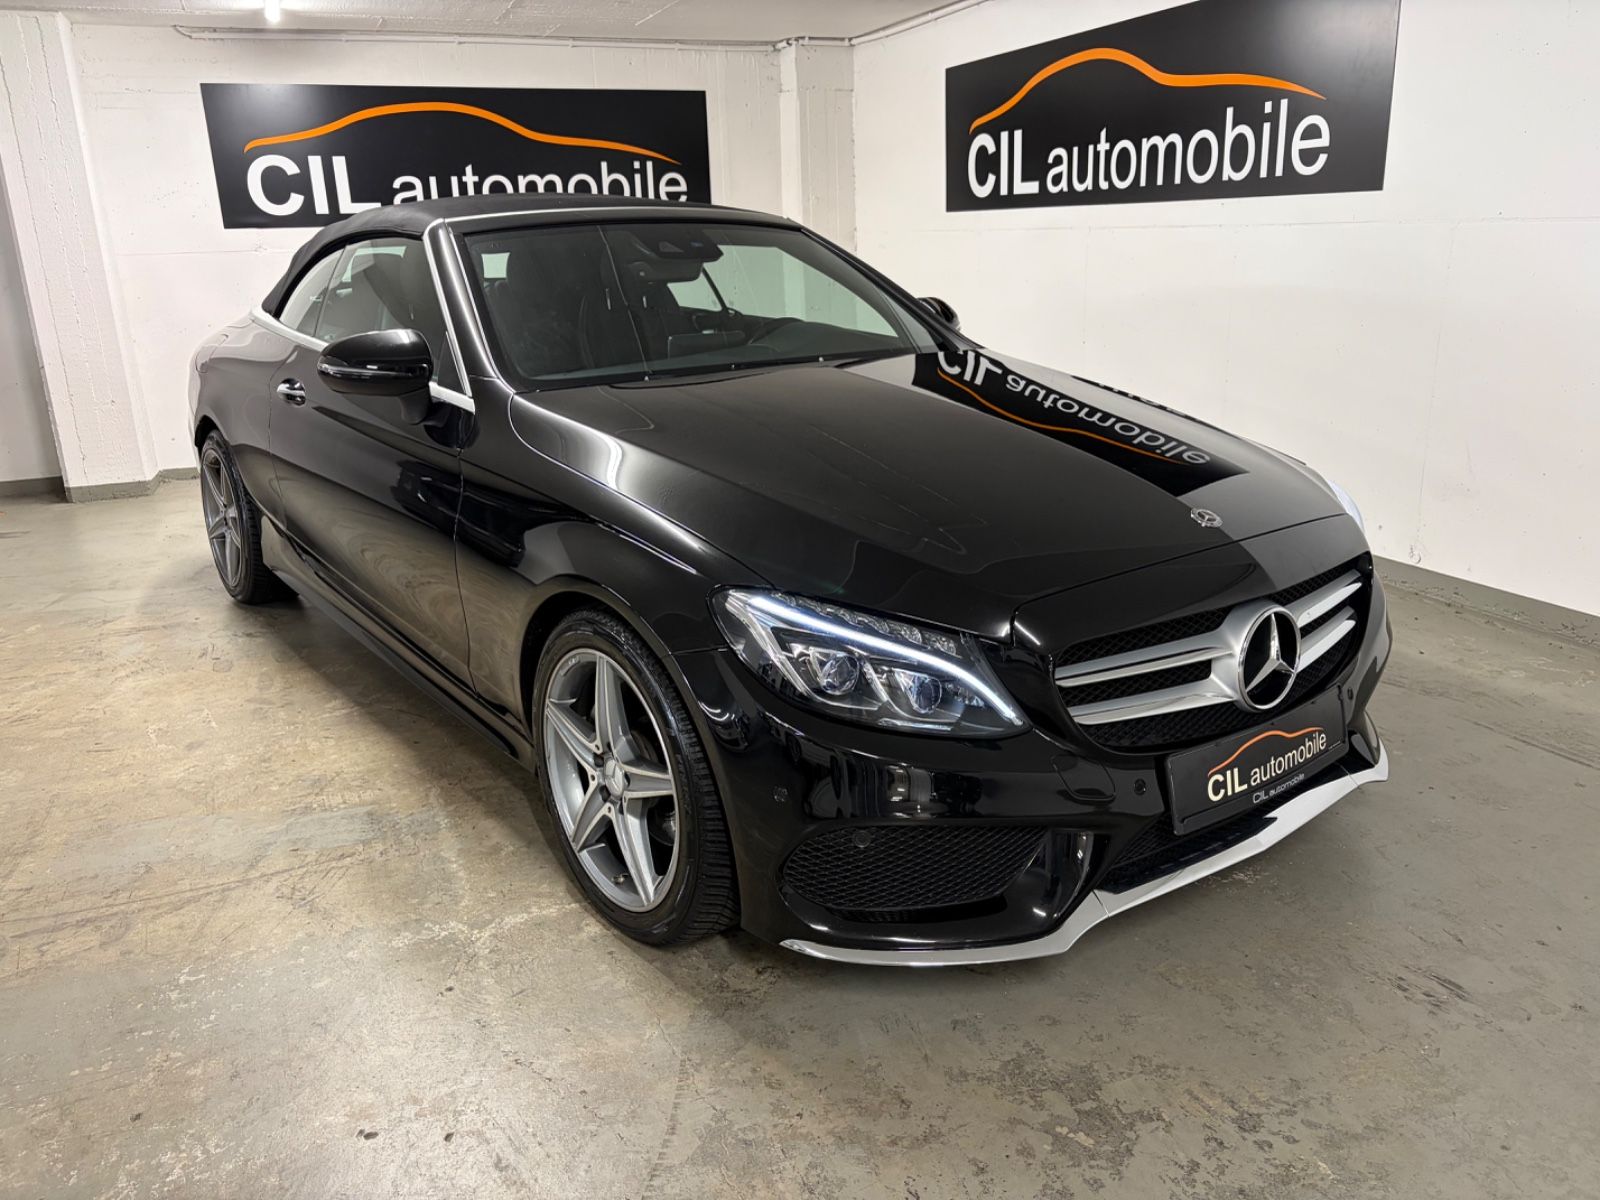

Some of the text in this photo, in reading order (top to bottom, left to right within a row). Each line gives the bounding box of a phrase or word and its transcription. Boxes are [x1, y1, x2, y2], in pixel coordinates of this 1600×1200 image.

[968, 98, 1331, 198] CIL automobile
[246, 154, 688, 216] CIL automobile
[1207, 732, 1327, 802] CIL automobile
[1253, 773, 1305, 804] CIL automobile
